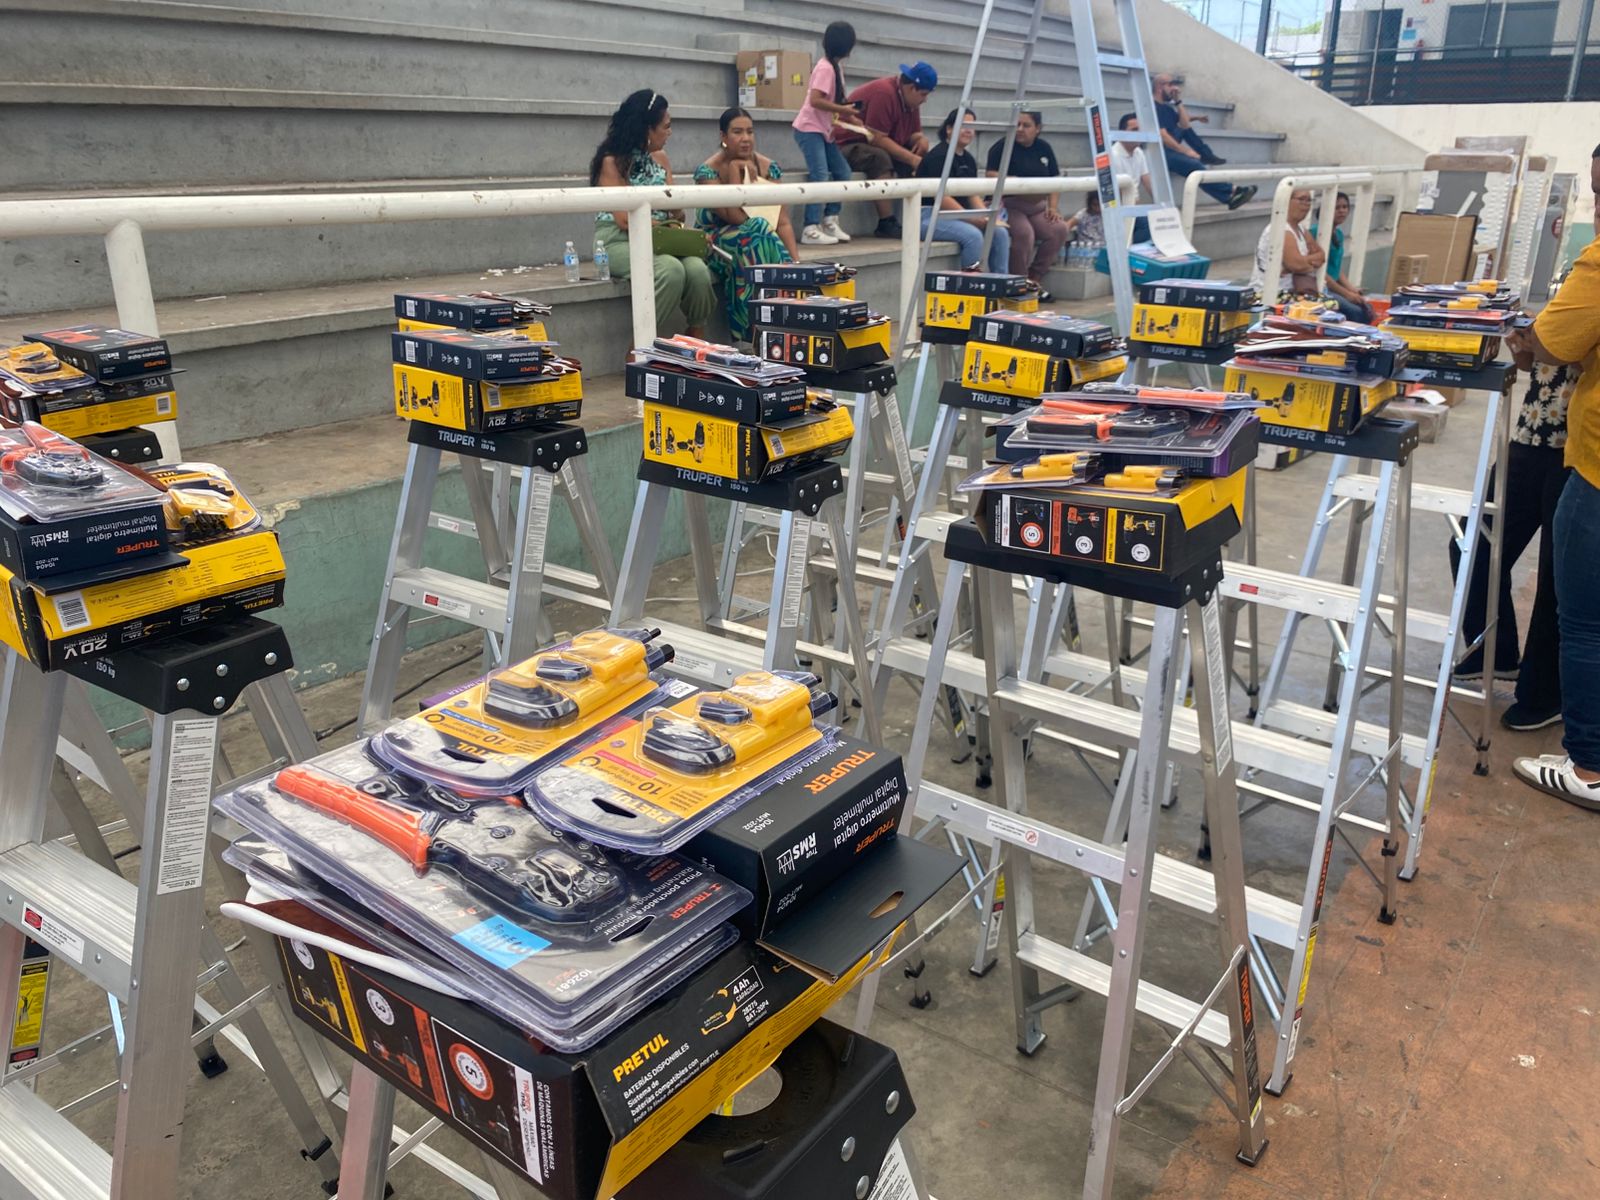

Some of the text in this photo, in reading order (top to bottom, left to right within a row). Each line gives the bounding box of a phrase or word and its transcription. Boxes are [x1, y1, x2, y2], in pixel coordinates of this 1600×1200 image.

[971, 392, 1010, 406] TRUPER
[438, 430, 475, 447] TRUPER
[1263, 424, 1316, 441] TRUPER
[676, 468, 723, 487] TRUPER
[86, 514, 157, 534] Digital multimeter
[46, 530, 69, 542] RMS
[86, 532, 112, 544] digital
[115, 540, 160, 554] TRUPER
[96, 661, 107, 673] 150
[483, 734, 506, 746] 10
[804, 749, 876, 795] TRUPER
[638, 782, 662, 796] 10
[612, 791, 673, 825] PRETUL
[832, 776, 899, 830] Digital multimeter
[793, 832, 816, 860] RMS
[834, 822, 859, 848] digital
[854, 817, 896, 854] TRUPER
[806, 847, 818, 859] True
[604, 870, 703, 936] Pinza ponchadora modular
[625, 891, 655, 914] modular
[670, 891, 712, 919] TRUPER
[593, 912, 623, 933] crimper
[556, 968, 592, 992] 102681
[733, 978, 750, 995] 4Ah
[736, 981, 759, 1002] CAPACIDAD
[1241, 966, 1251, 1026] TRUPER
[612, 1033, 669, 1082] PRETUL
[465, 1065, 477, 1079] 5
[623, 1042, 690, 1099] BATERÍAS DISPONIBLES
[654, 1066, 689, 1097] compatibles
[687, 1058, 699, 1070] con
[522, 1079, 531, 1112] TRUPER
[536, 1081, 543, 1091] DE
[627, 1079, 660, 1108] Sistema de
[537, 1091, 547, 1128] MÁQUINAS
[543, 1084, 552, 1124] CONTAMOS
